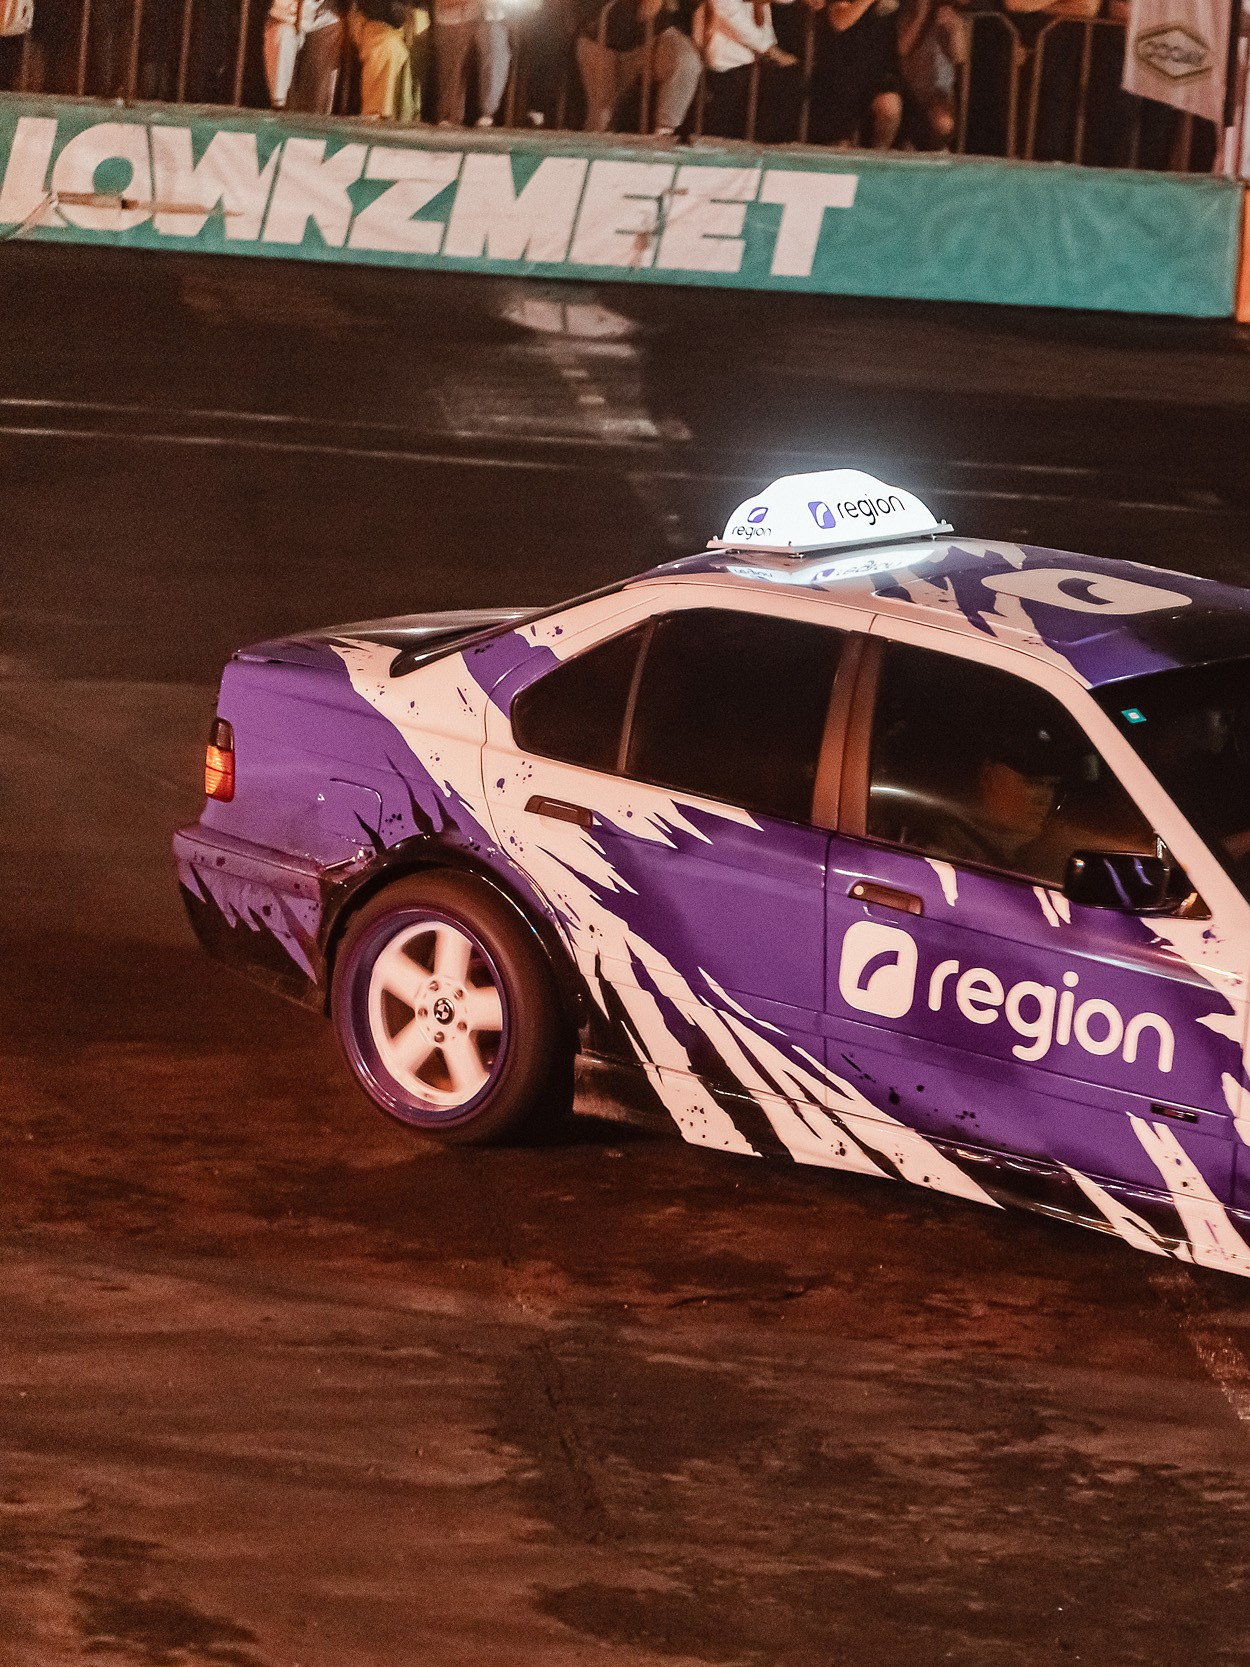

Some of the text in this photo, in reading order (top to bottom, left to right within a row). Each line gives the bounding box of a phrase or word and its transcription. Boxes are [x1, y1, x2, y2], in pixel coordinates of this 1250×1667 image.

[836, 493, 906, 526] region
[731, 524, 772, 541] region
[927, 959, 1175, 1073] region
